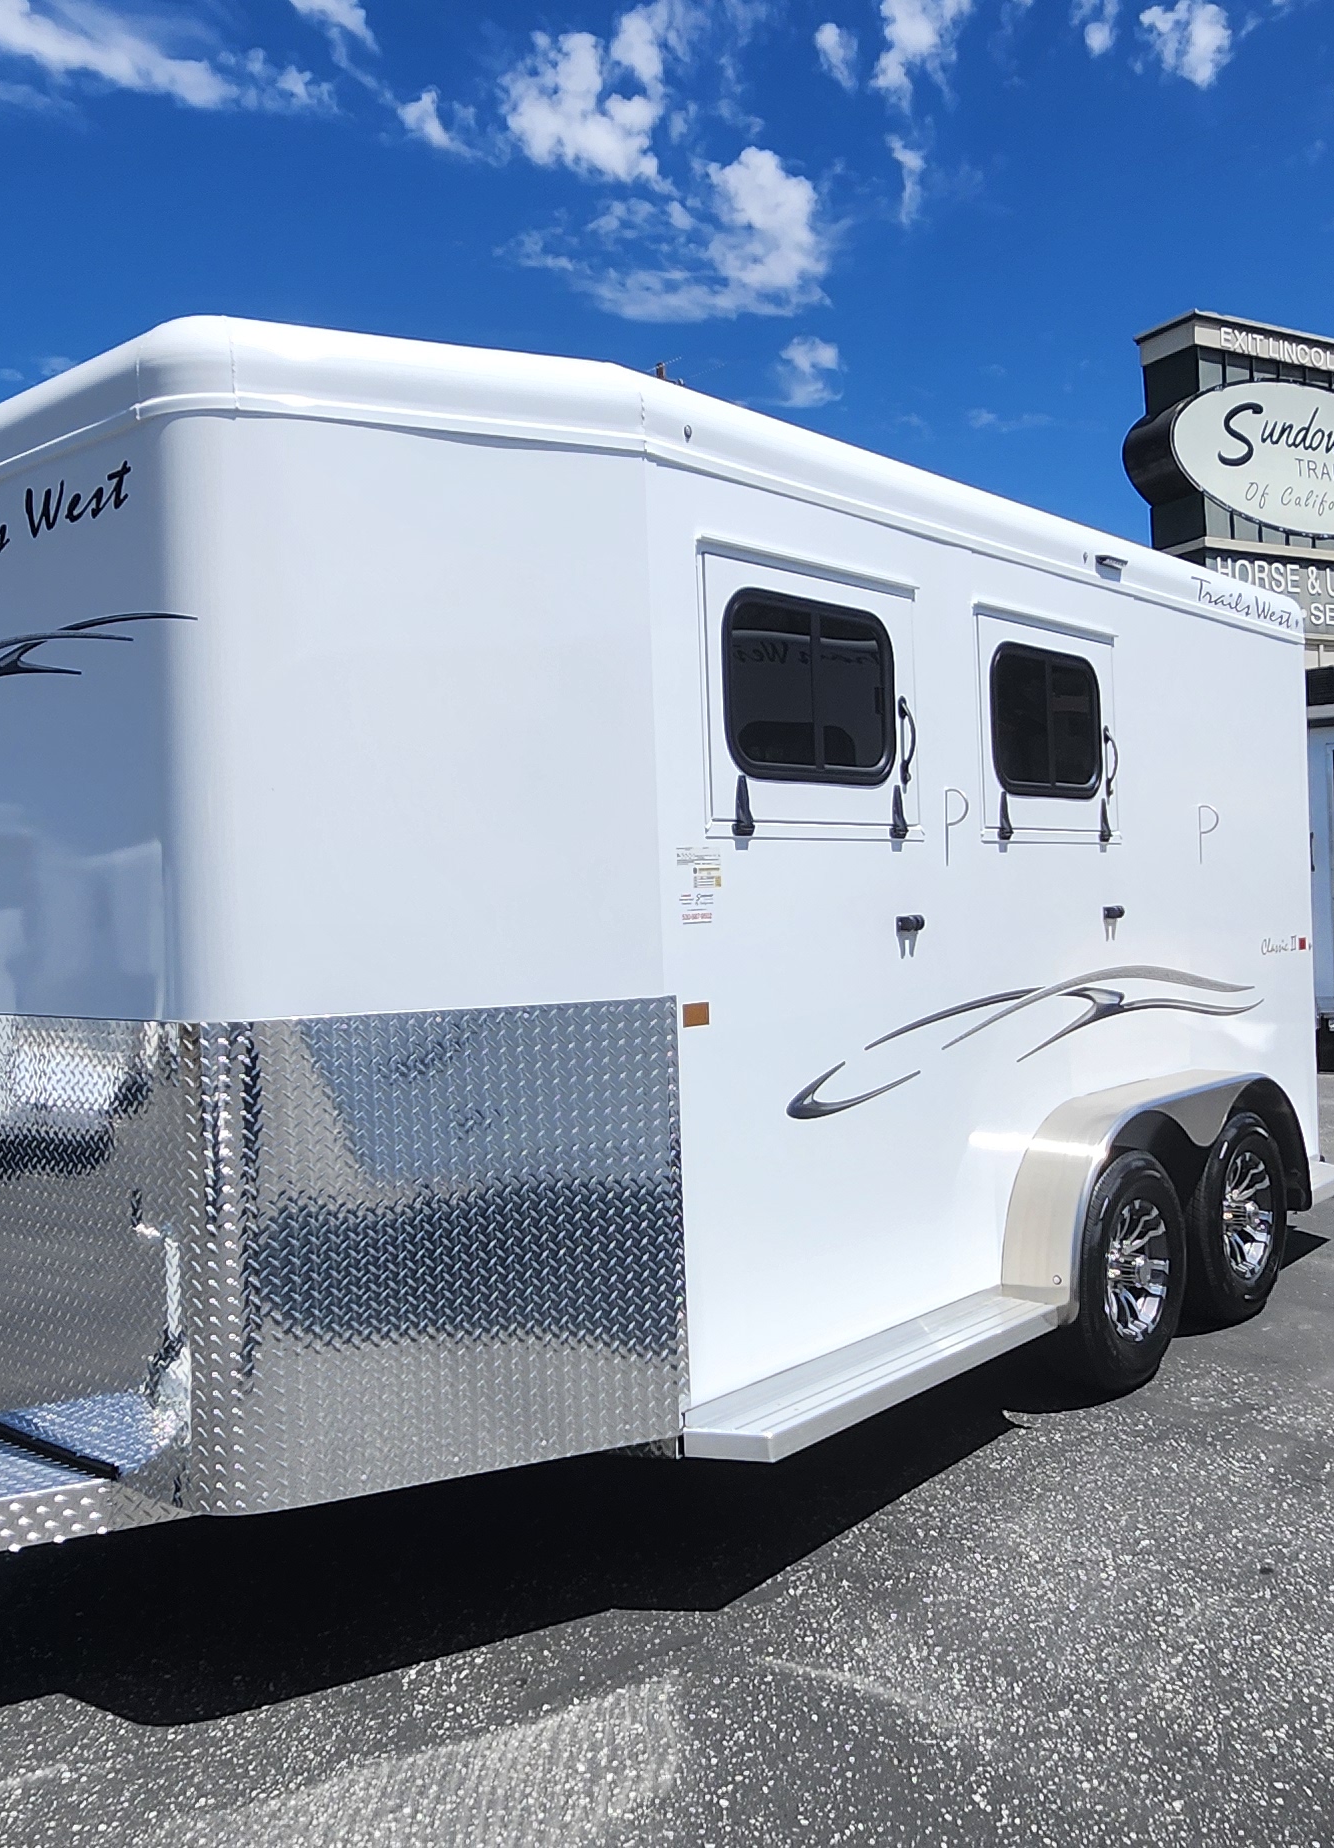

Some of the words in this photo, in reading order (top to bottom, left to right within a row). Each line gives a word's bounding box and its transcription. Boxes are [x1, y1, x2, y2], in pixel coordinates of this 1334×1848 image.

[1220, 326, 1264, 355] EXIT
[24, 460, 131, 538] West
[1245, 481, 1270, 510] Of
[1217, 556, 1302, 594] HORSE
[1306, 565, 1323, 596] &
[1190, 575, 1251, 618] Trails
[1254, 595, 1293, 629] West
[1261, 938, 1289, 956] Classic
